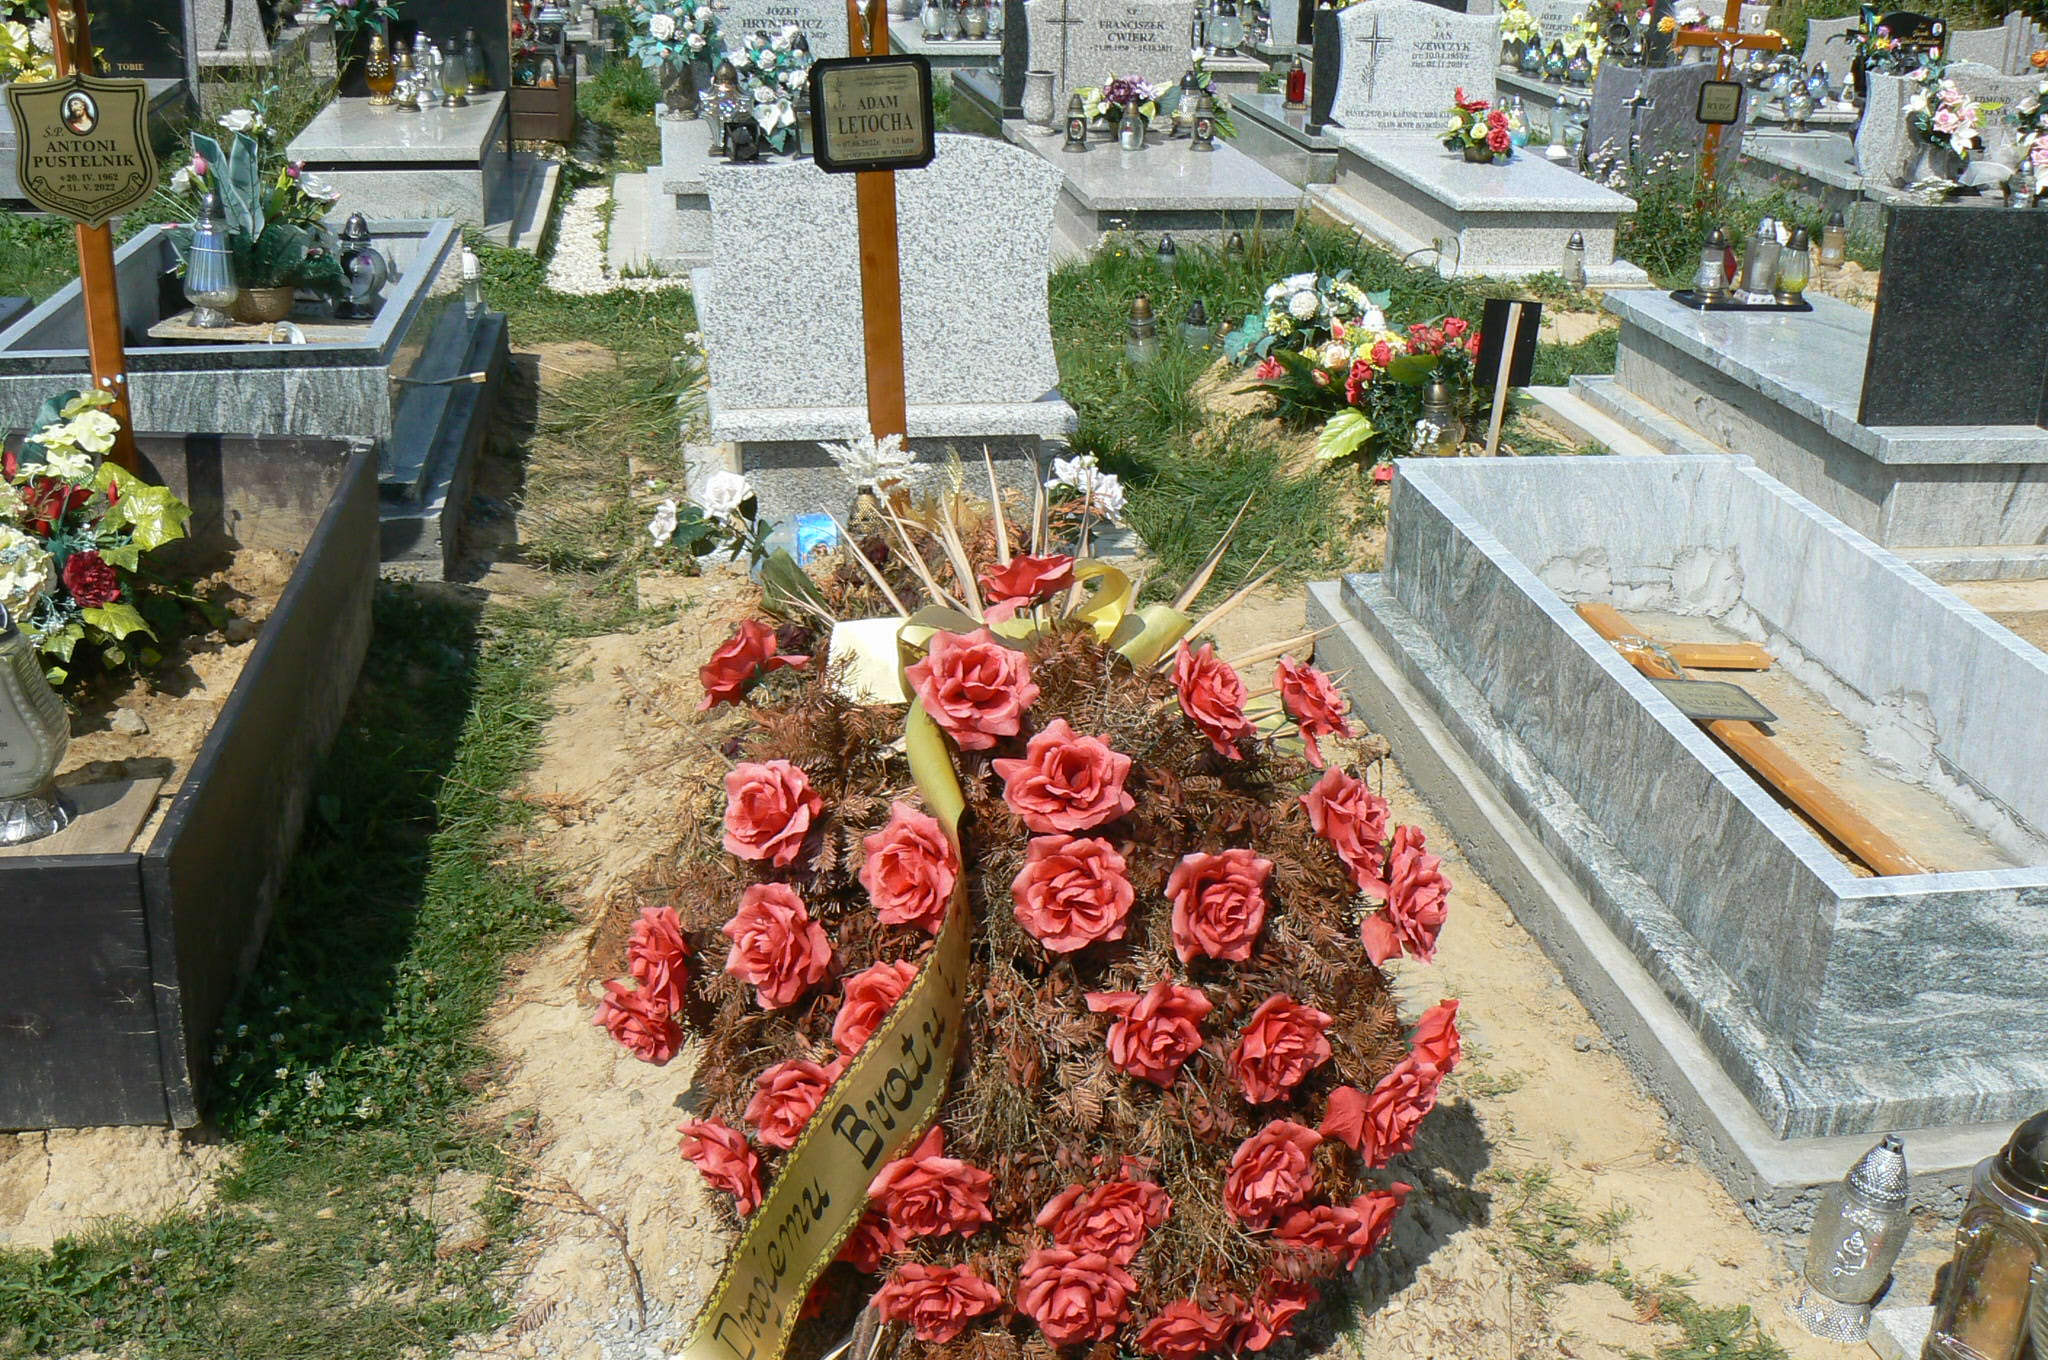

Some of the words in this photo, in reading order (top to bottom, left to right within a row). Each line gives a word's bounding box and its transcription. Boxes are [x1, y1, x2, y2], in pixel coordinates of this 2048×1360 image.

[1099, 20, 1165, 30] FRANCISZEK
[116, 63, 145, 71] TOBIE
[857, 95, 899, 110] ADAM
[838, 112, 913, 139] LĘTOCHA
[46, 139, 116, 153] ANTONI
[33, 154, 136, 168] PUSTELNIK
[94, 183, 116, 192] 2022
[831, 1007, 947, 1171] Bratu
